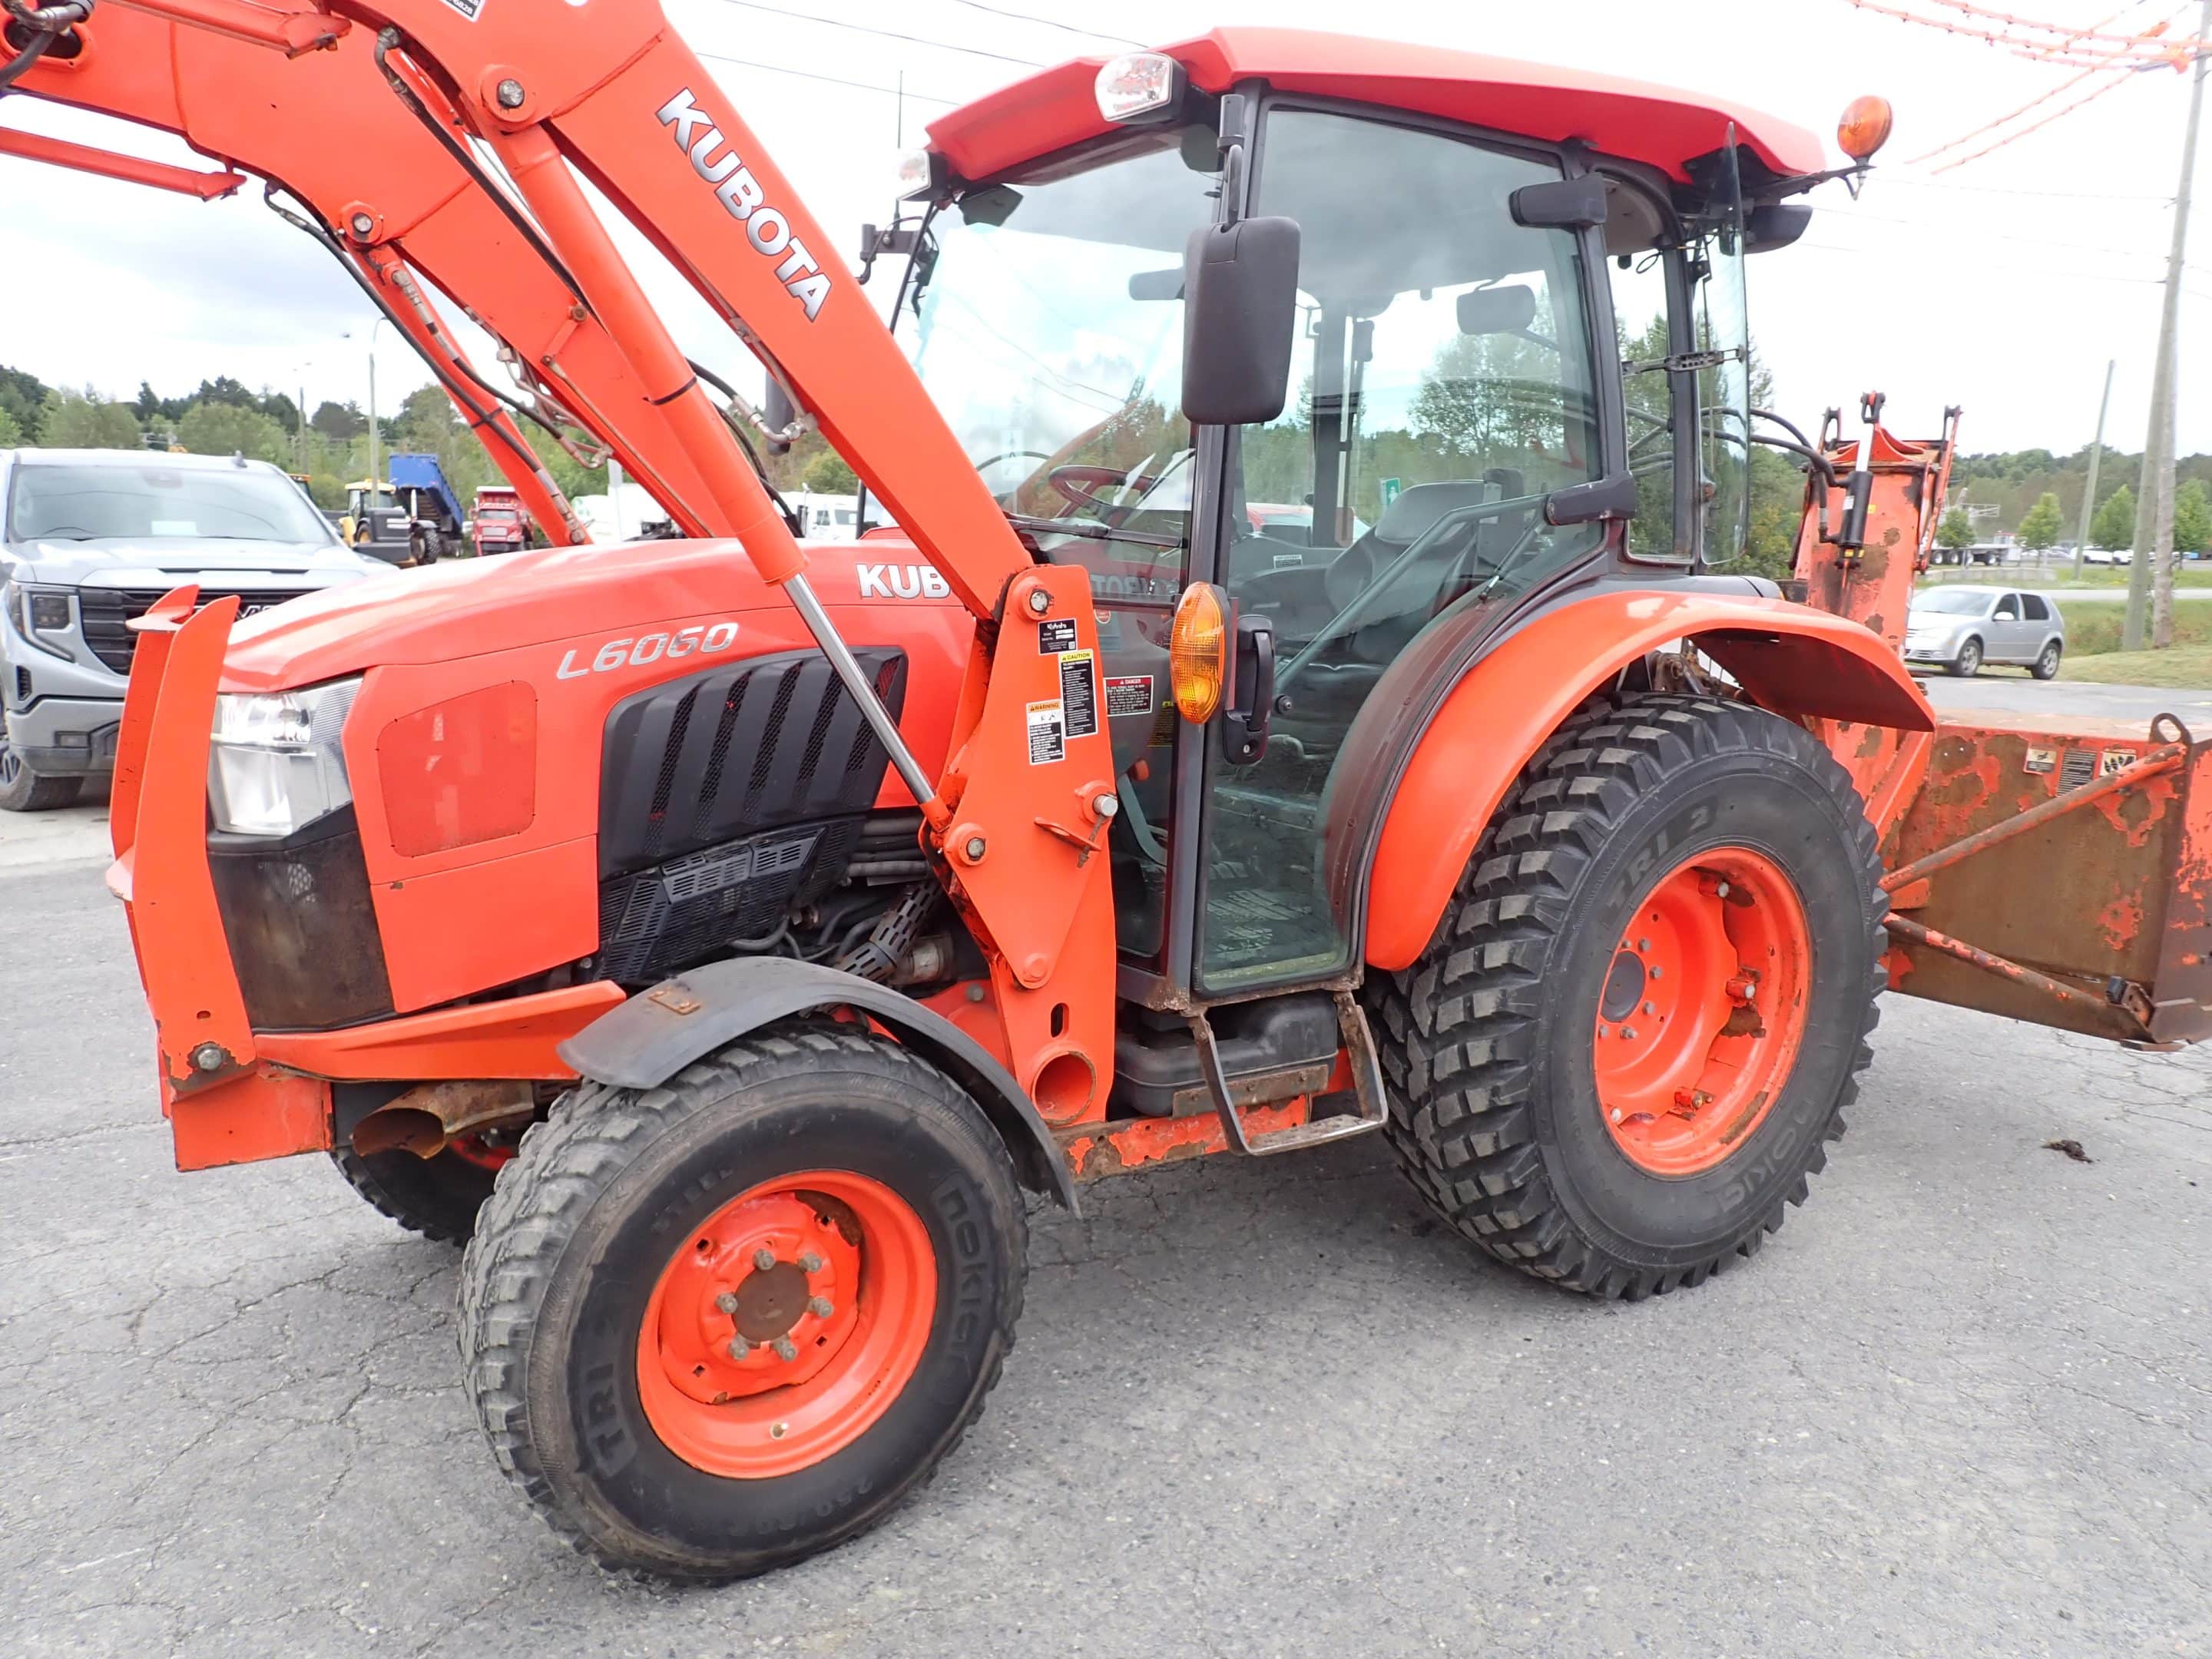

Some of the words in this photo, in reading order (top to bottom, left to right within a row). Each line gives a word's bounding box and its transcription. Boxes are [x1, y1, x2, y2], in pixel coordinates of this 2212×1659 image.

[655, 87, 832, 323] KUBOTA
[555, 622, 739, 680] L6060
[1067, 652, 1090, 661] CAUTION
[1035, 702, 1059, 710] WARNING
